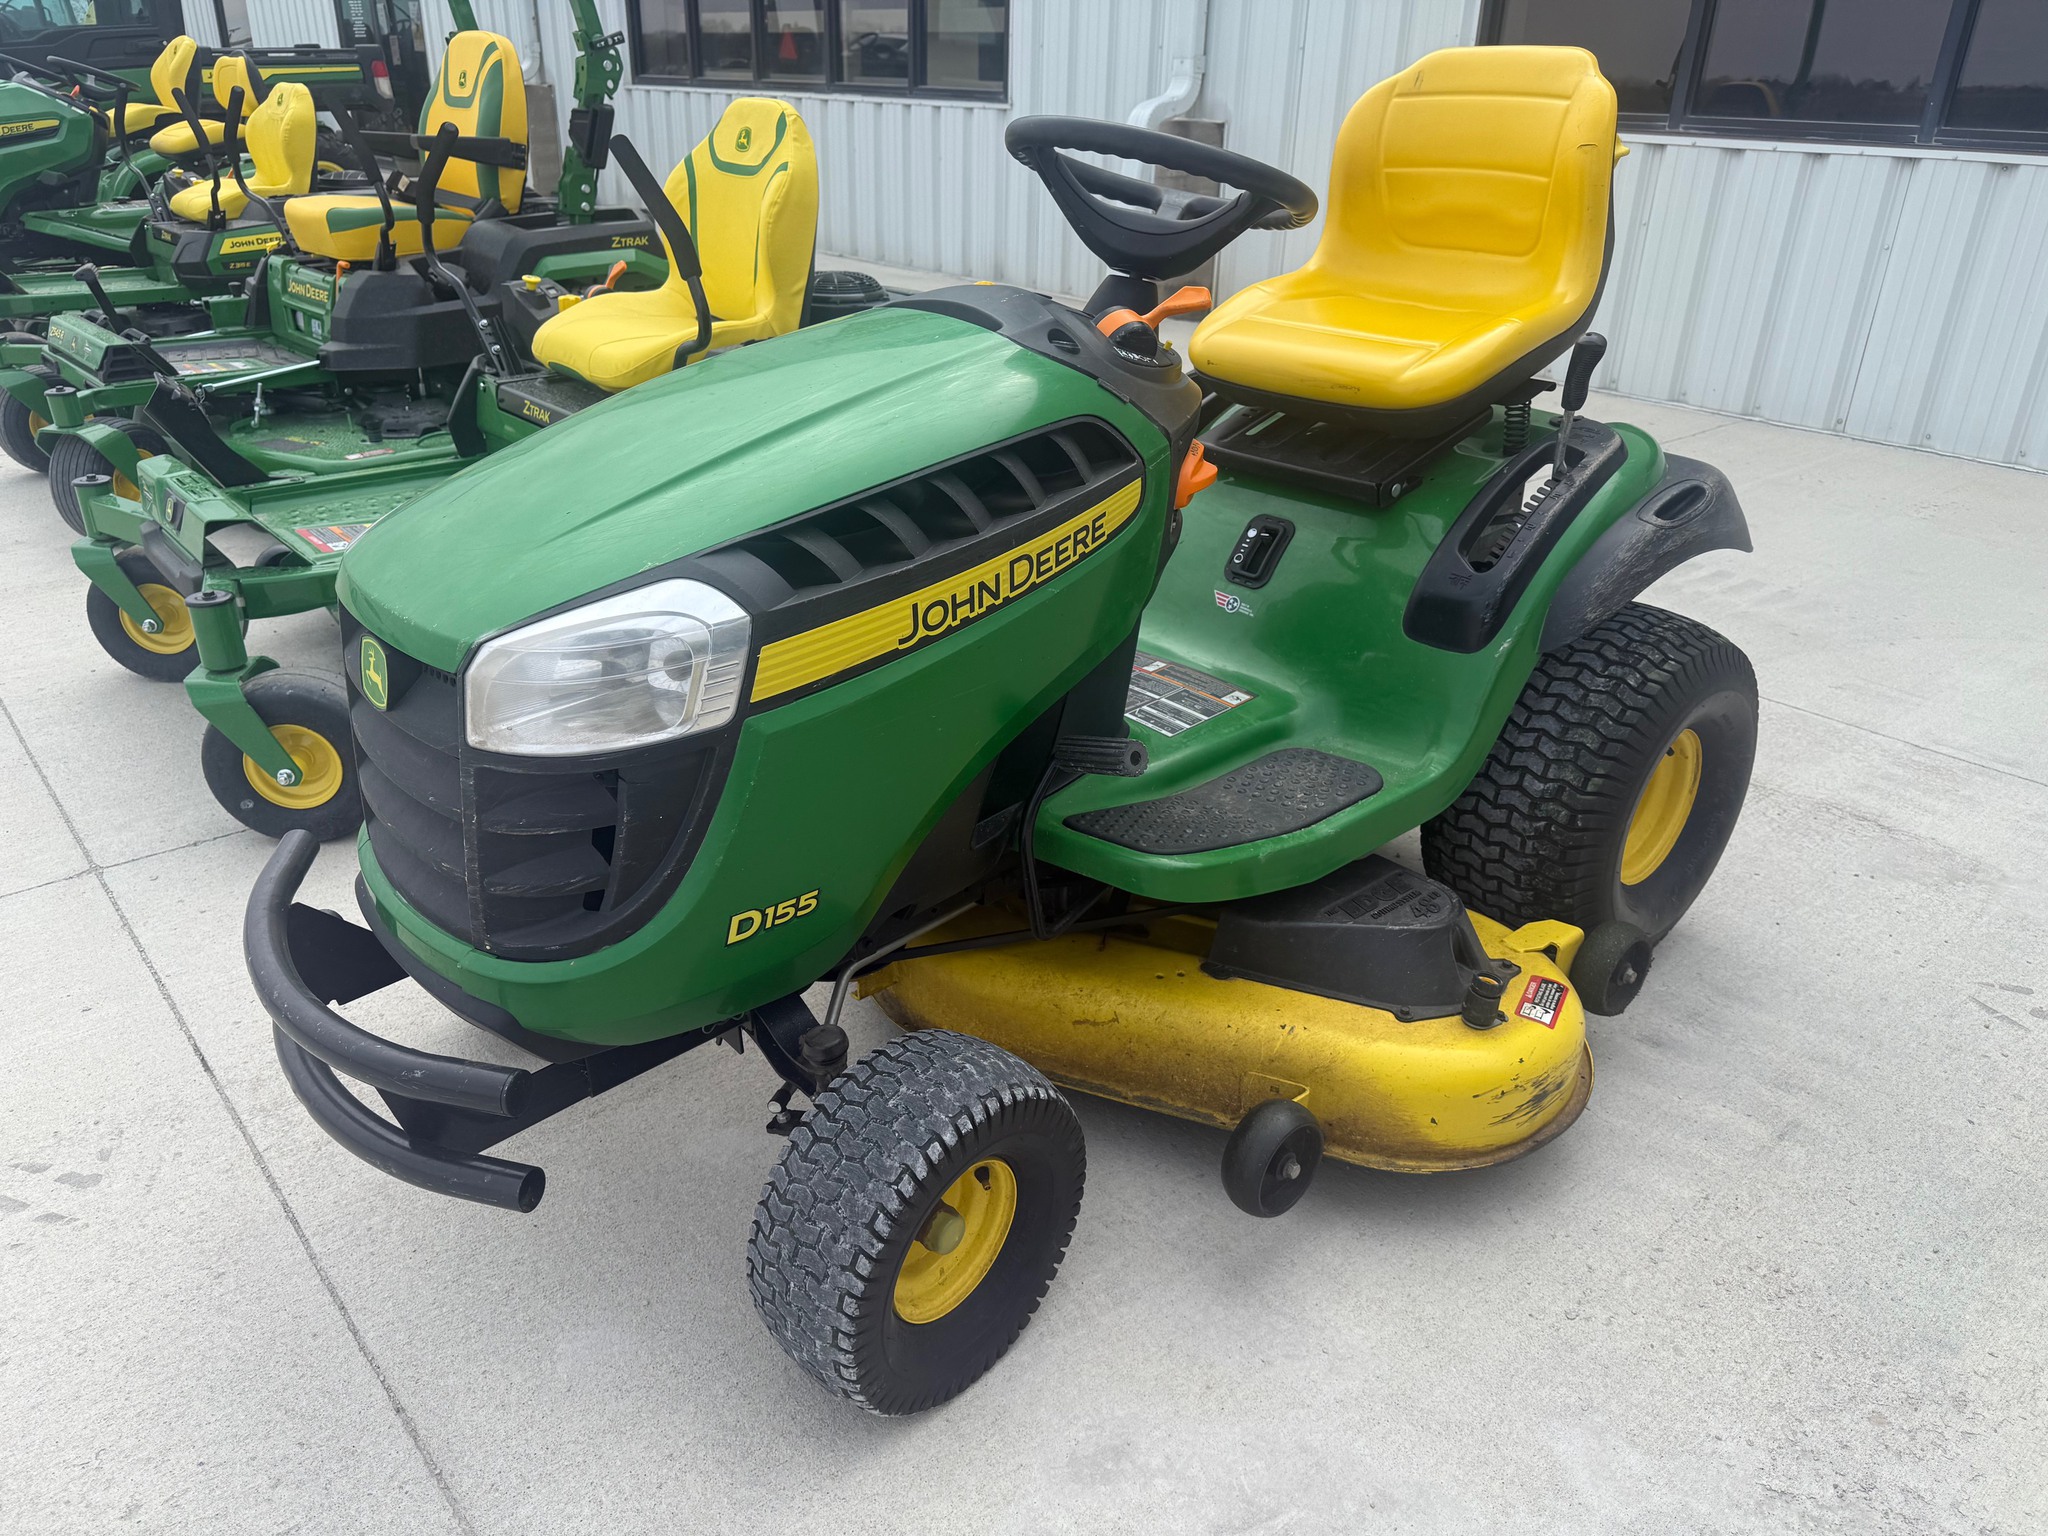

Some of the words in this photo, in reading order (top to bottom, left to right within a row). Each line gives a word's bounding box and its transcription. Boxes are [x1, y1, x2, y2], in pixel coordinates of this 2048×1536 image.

[1, 123, 34, 134] DEERE
[229, 239, 255, 249] JOHN
[611, 236, 649, 248] ZTRAK
[288, 280, 305, 297] JOHN
[305, 283, 329, 302] DEERE
[523, 400, 550, 424] ZTRAK
[898, 571, 1001, 648] JOHN
[1009, 511, 1107, 597] DEERE
[726, 888, 820, 946] D155
